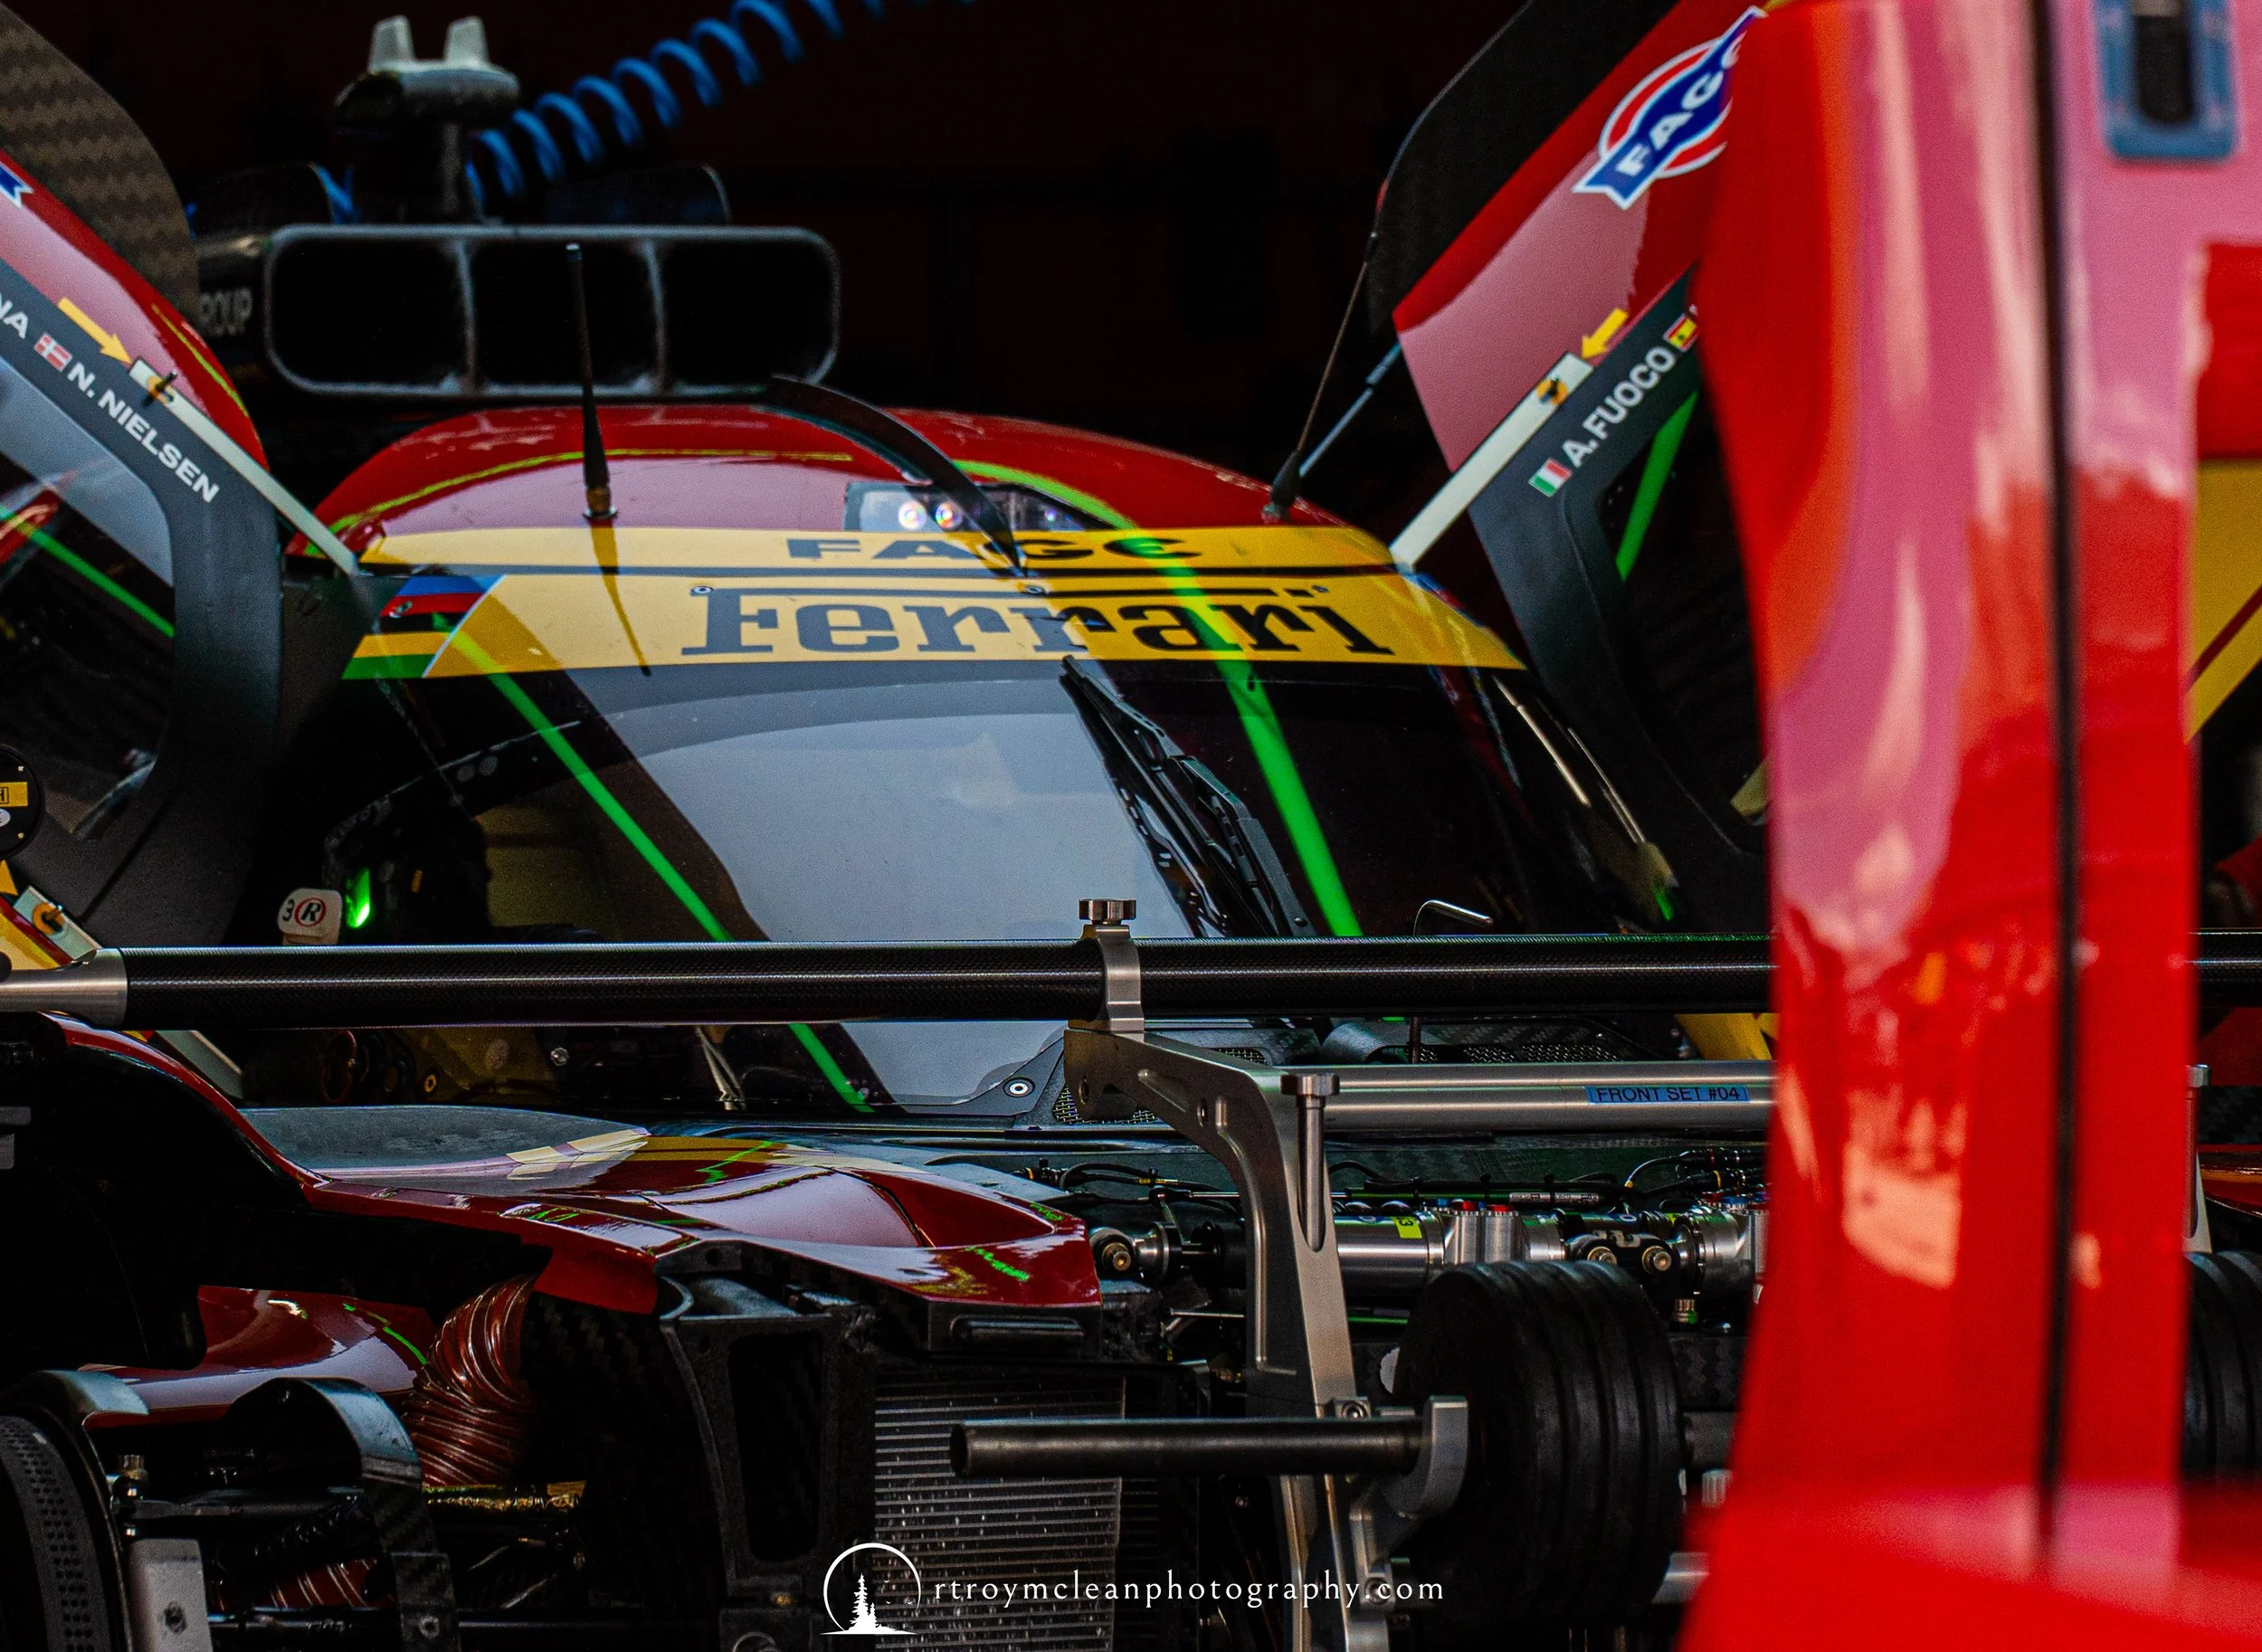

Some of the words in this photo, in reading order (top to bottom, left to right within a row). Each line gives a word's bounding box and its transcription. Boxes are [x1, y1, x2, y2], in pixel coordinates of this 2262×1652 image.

[67, 362, 96, 398] N.
[98, 388, 221, 503] NIELSEN
[681, 587, 1396, 656] Ferrari
[1596, 1087, 1660, 1102] FRONT
[1668, 1087, 1701, 1102] SET
[1707, 1087, 1740, 1101] #04
